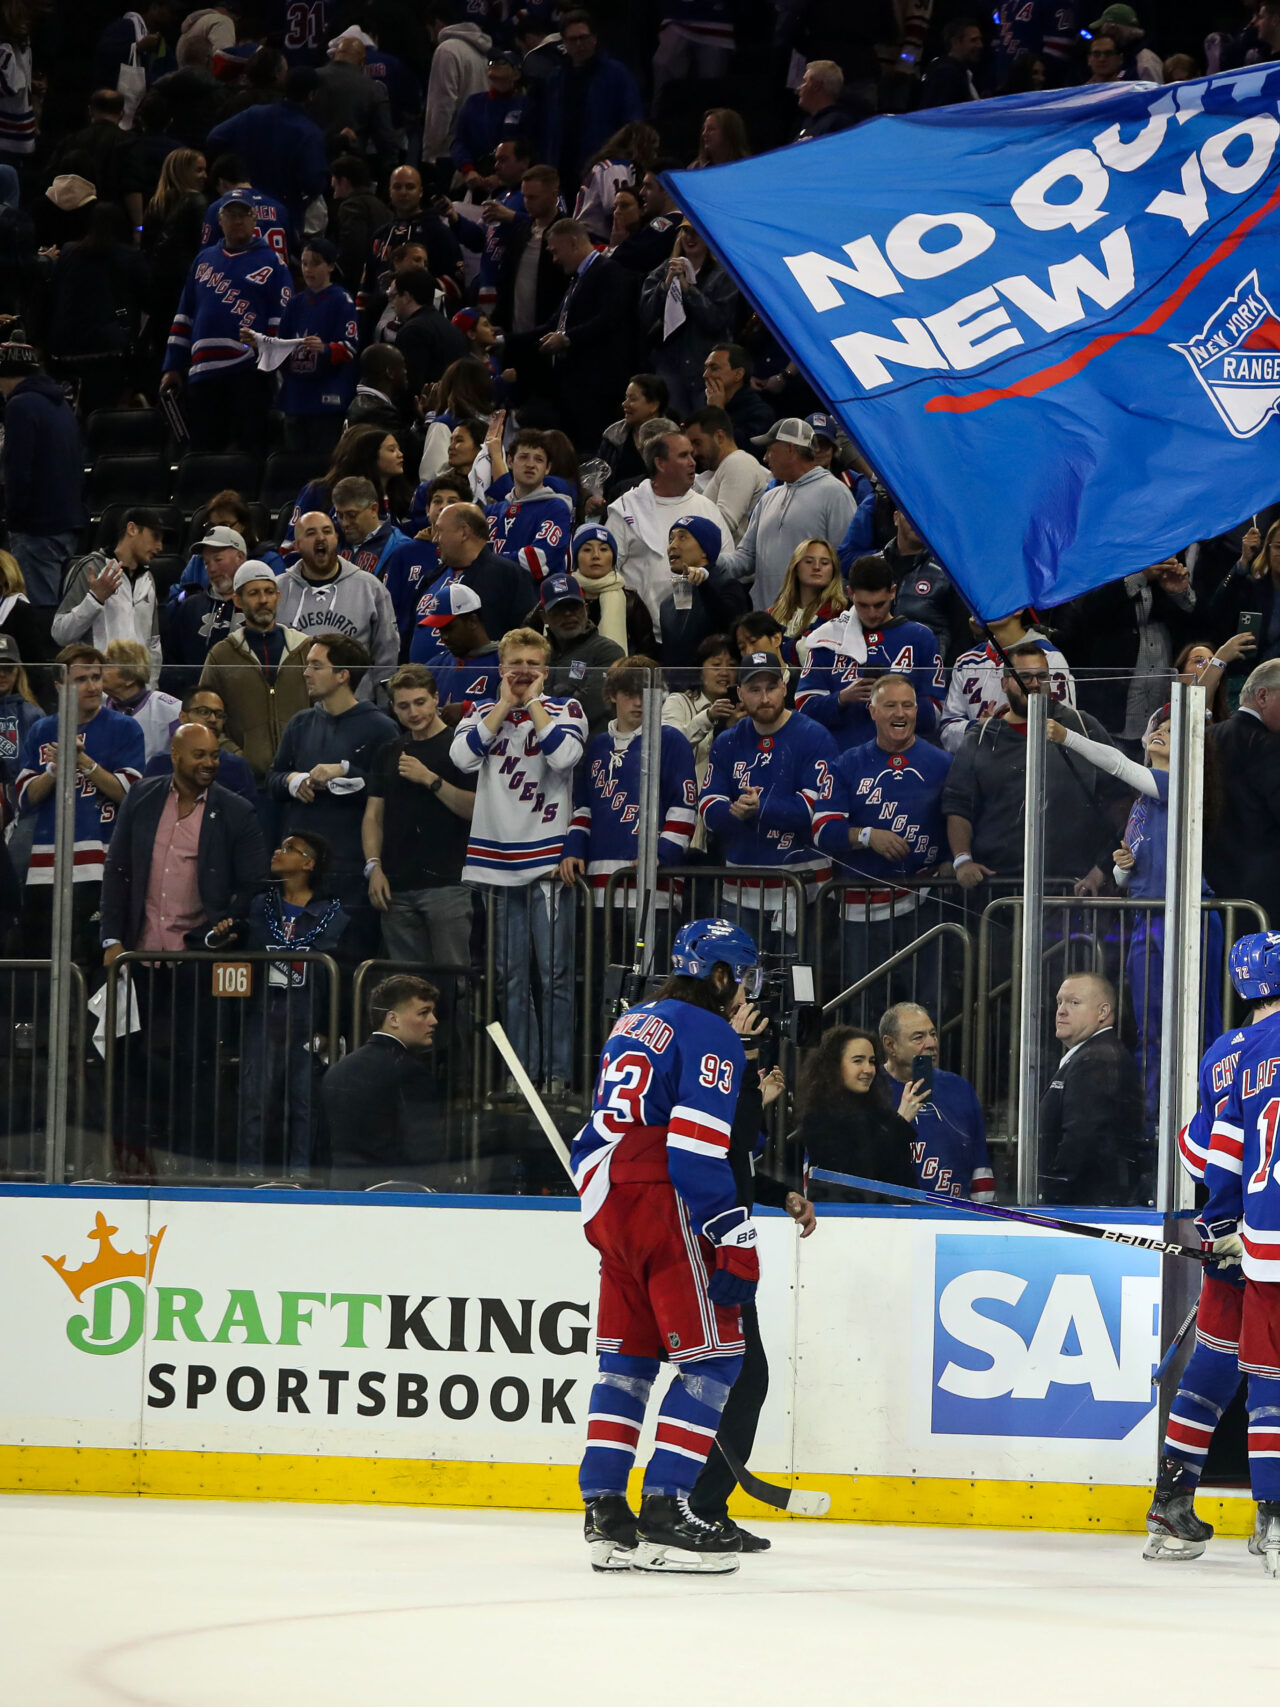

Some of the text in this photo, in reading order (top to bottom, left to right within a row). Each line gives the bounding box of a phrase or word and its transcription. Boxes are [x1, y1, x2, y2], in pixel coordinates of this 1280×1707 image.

[253, 204, 277, 221] HEN
[246, 265, 275, 285] A
[783, 212, 996, 314] NO
[197, 261, 257, 327] RANGERS
[831, 225, 1136, 391] NEW
[1190, 294, 1264, 363] NEW YORK
[540, 519, 563, 546] 36
[891, 645, 914, 673] A
[465, 675, 489, 695] A
[489, 738, 558, 824] ANGERS
[814, 760, 834, 800] 23
[856, 777, 939, 865] RANGERS
[217, 967, 248, 992] 106
[698, 1053, 734, 1095] 93
[66, 1281, 600, 1356] DRAFTKING
[147, 1363, 578, 1424] SPORTSBOOK
